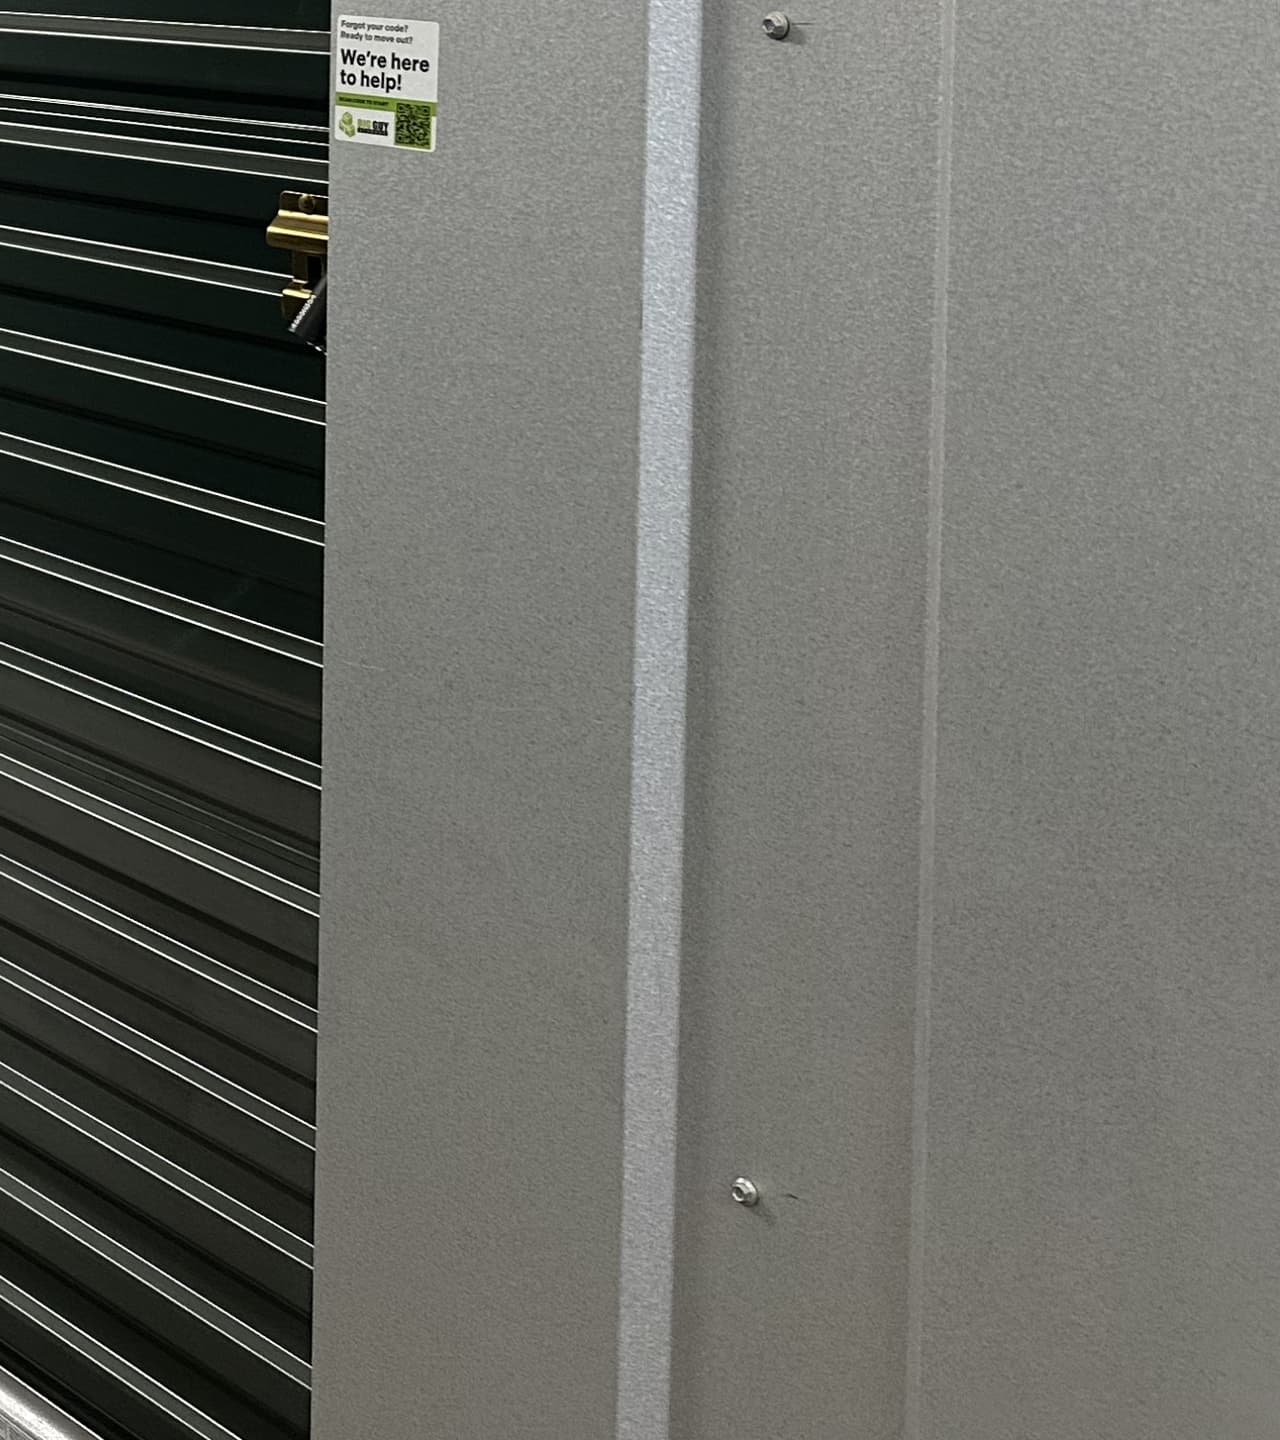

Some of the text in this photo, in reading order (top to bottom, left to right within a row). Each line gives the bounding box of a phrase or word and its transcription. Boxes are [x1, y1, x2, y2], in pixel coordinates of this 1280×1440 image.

[341, 20, 409, 33] Forgot your code?
[340, 31, 363, 42] Ready
[396, 36, 413, 44] out?
[340, 48, 430, 72] We're here
[340, 69, 402, 93] to help!
